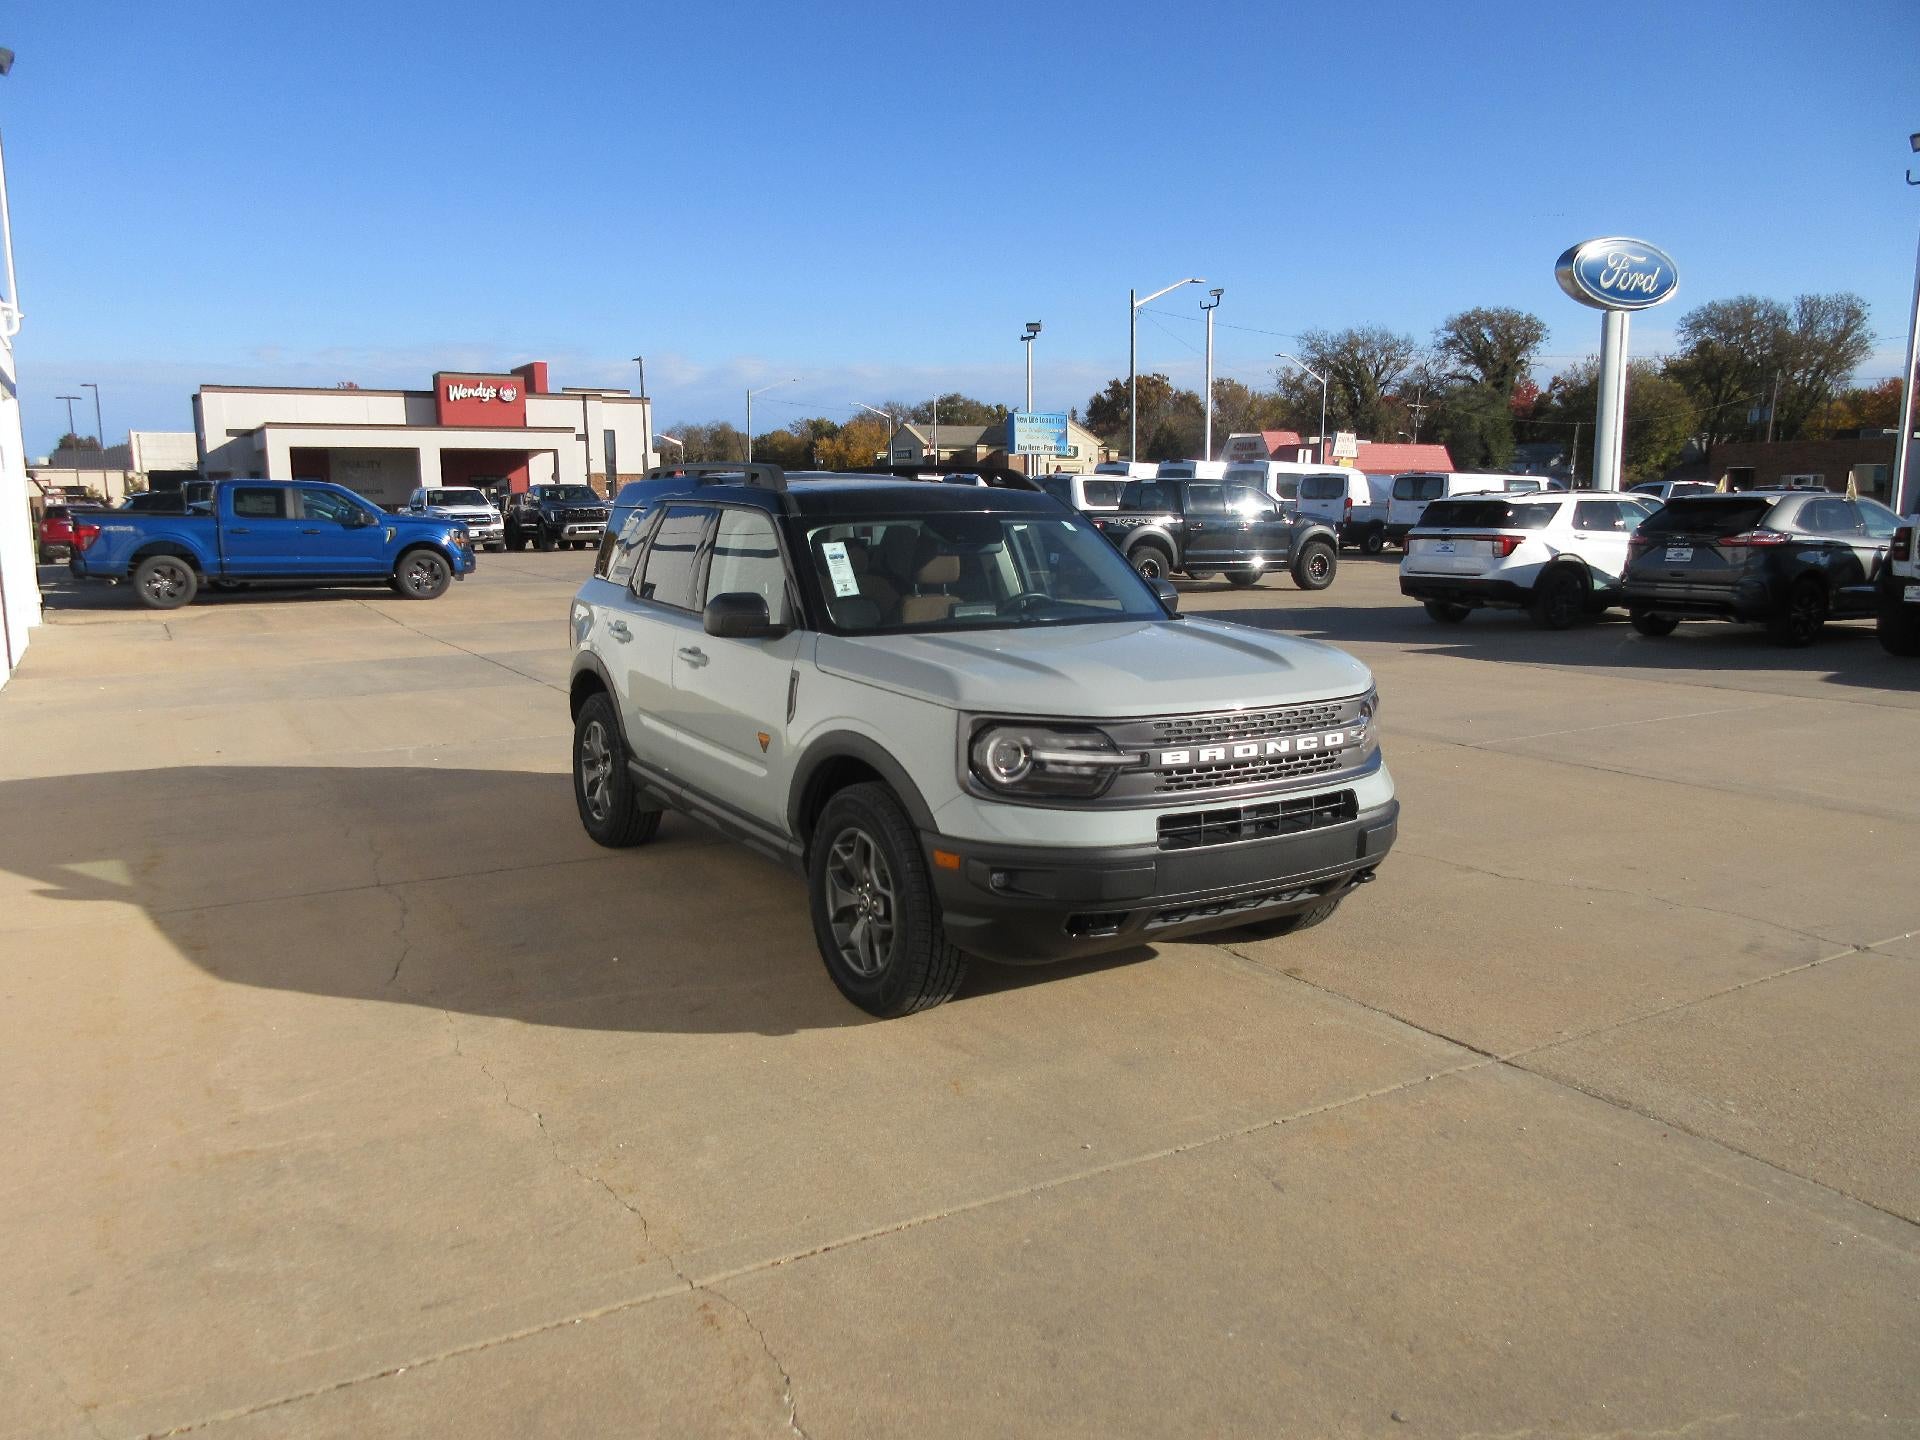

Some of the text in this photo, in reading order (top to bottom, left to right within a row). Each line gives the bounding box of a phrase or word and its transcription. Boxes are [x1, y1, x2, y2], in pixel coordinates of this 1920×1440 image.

[1600, 252, 1660, 294] Ford
[449, 382, 497, 402] Wendy's
[1016, 416, 1028, 424] New
[1029, 416, 1039, 424] Life
[1017, 443, 1028, 452] Buy
[1160, 733, 1344, 765] BRONCO
